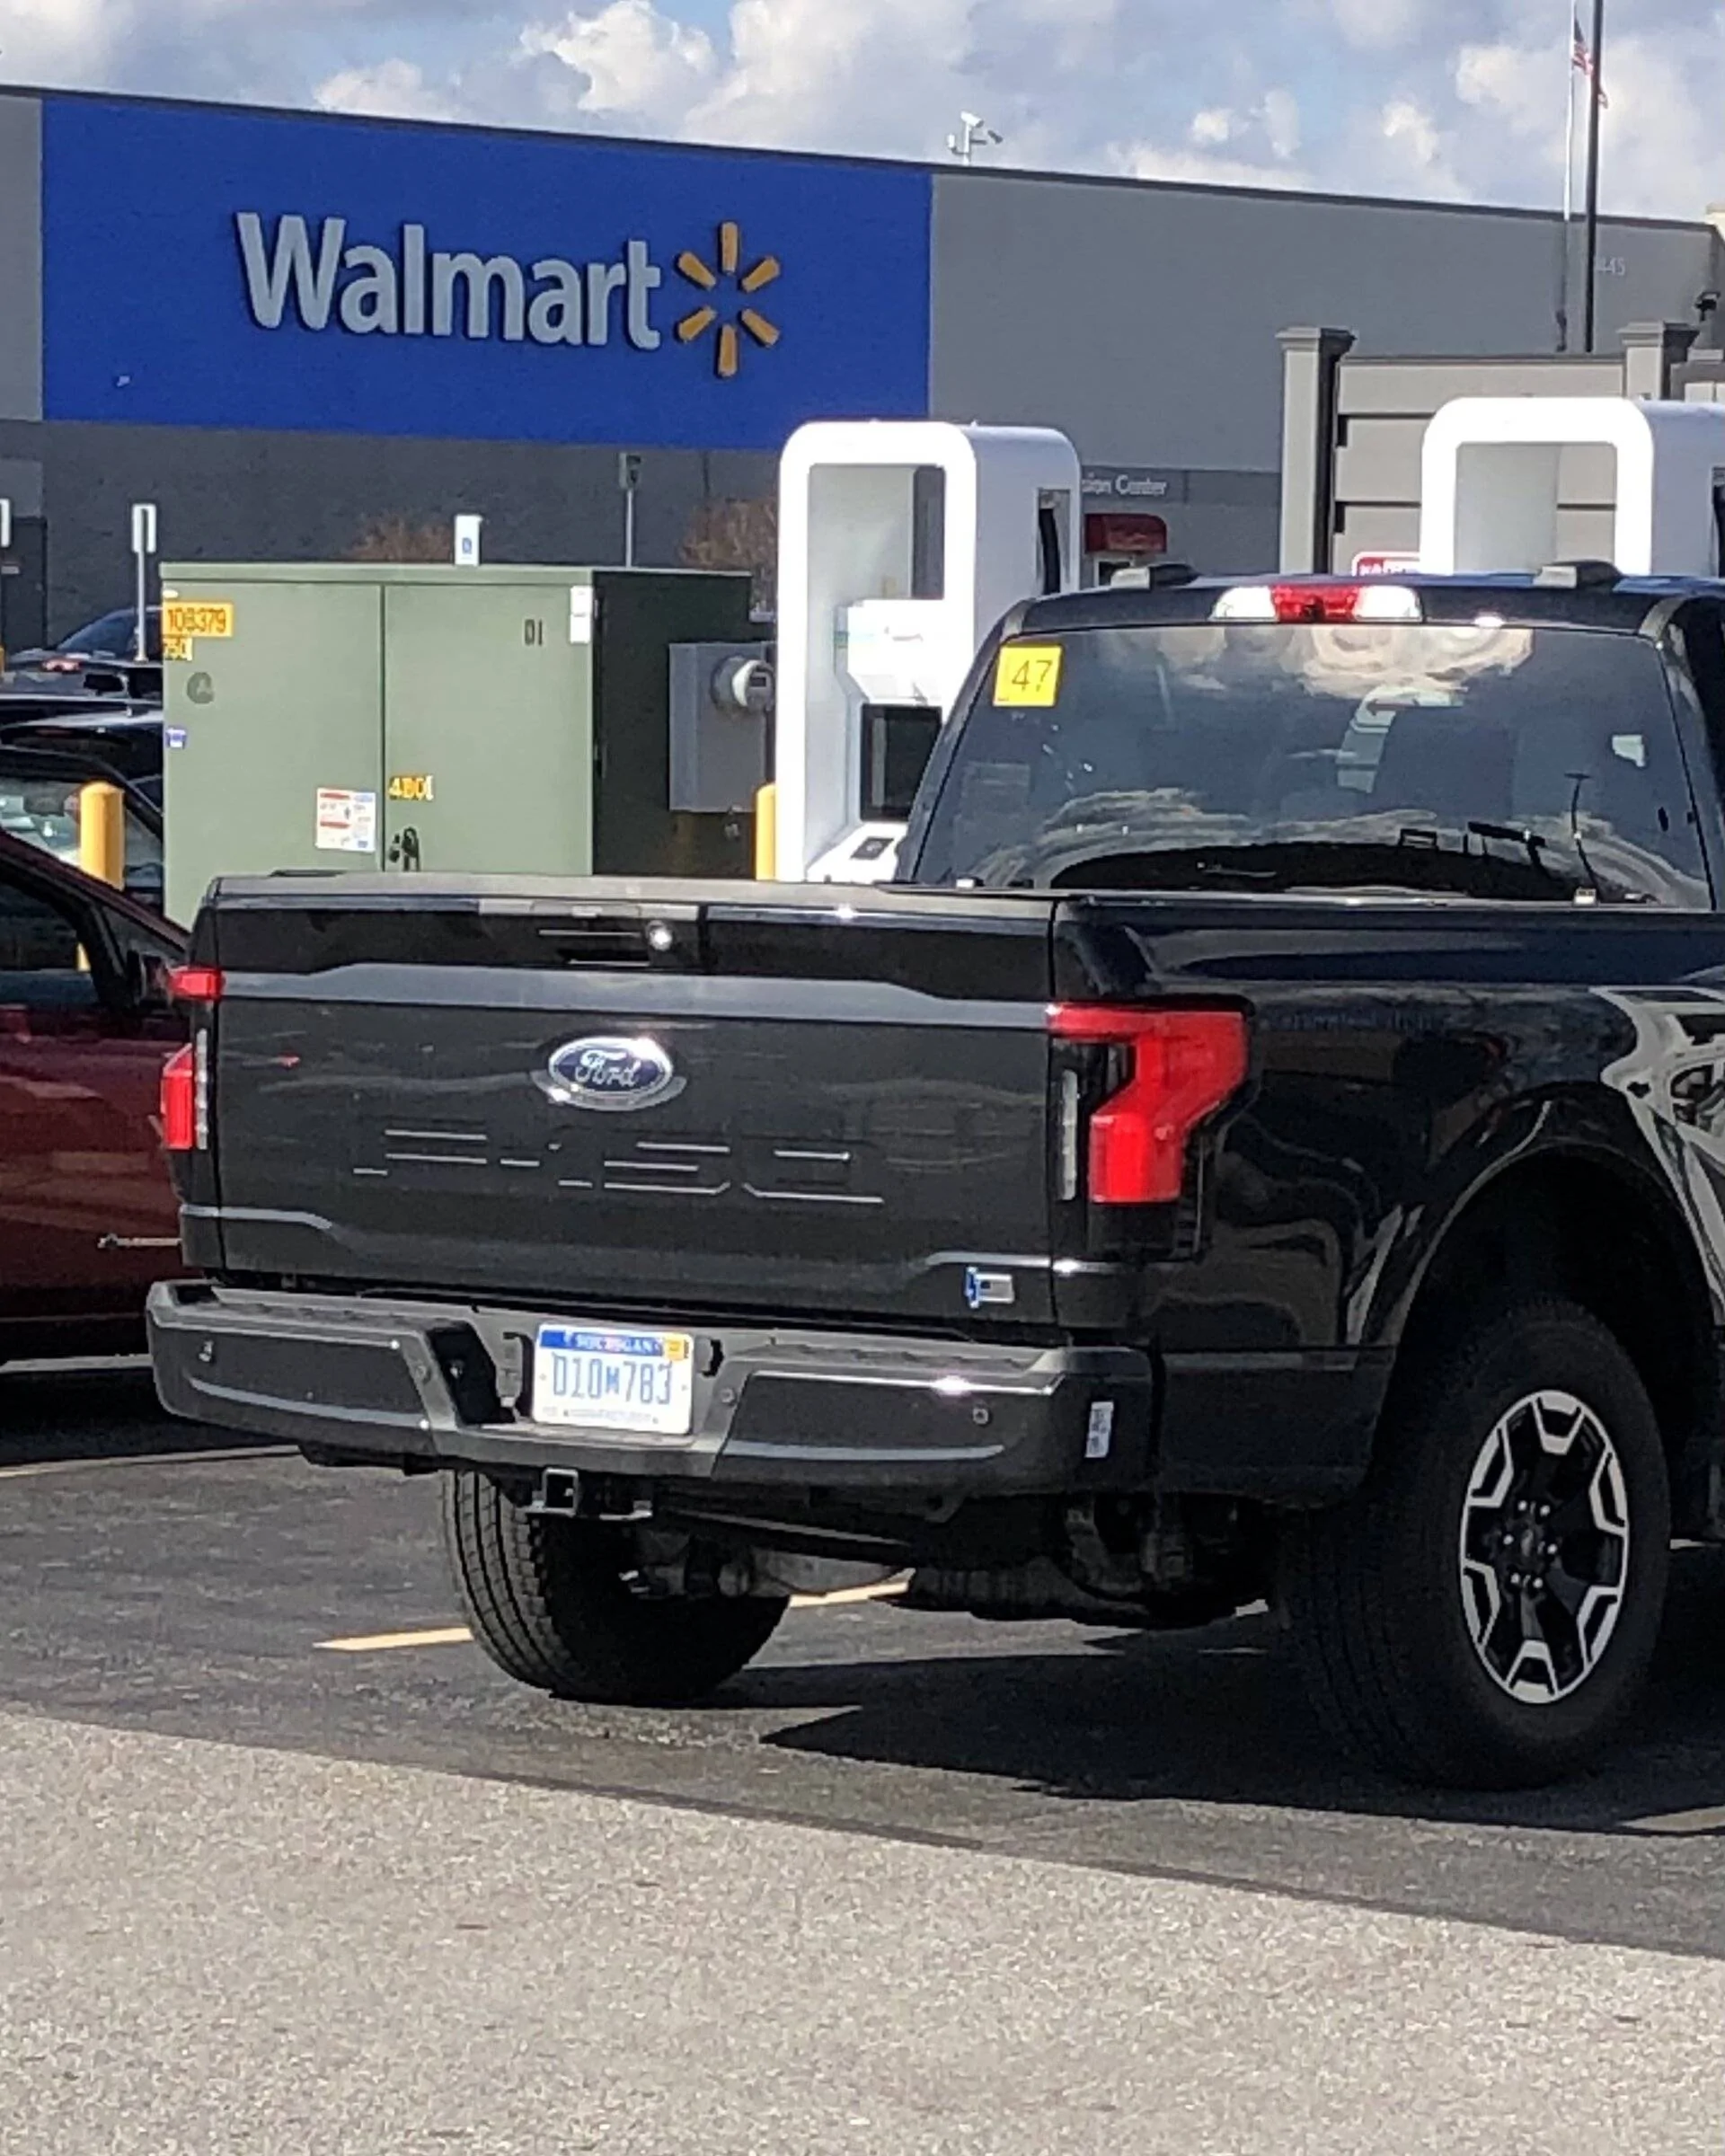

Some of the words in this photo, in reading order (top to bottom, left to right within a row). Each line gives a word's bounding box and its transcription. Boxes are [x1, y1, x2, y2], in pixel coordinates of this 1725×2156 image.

[235, 210, 661, 351] Walmart
[1115, 474, 1167, 495] Center
[1012, 659, 1053, 692] 47
[575, 1048, 641, 1088] Ford
